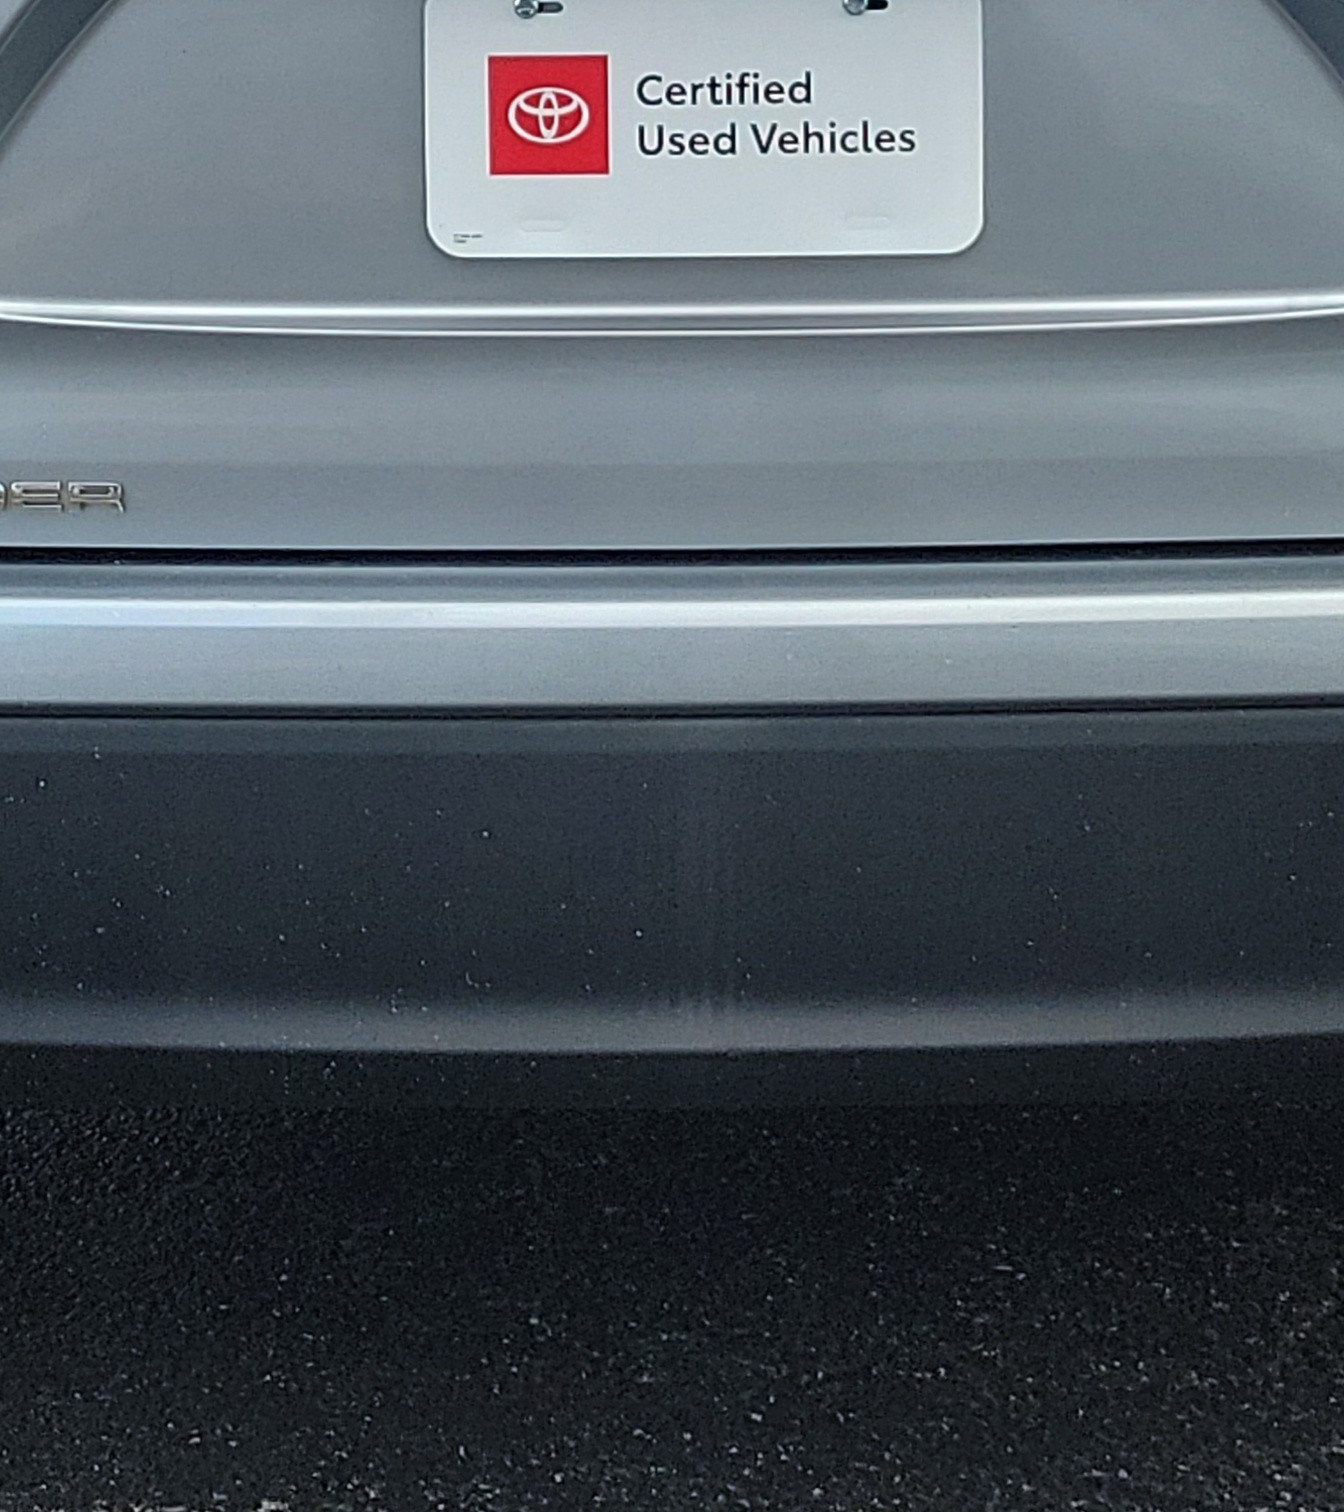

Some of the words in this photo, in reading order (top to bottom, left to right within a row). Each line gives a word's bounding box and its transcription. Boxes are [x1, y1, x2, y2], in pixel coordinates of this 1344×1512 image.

[636, 70, 812, 106] Certified
[636, 122, 737, 156] Used
[750, 119, 916, 154] Vehicles
